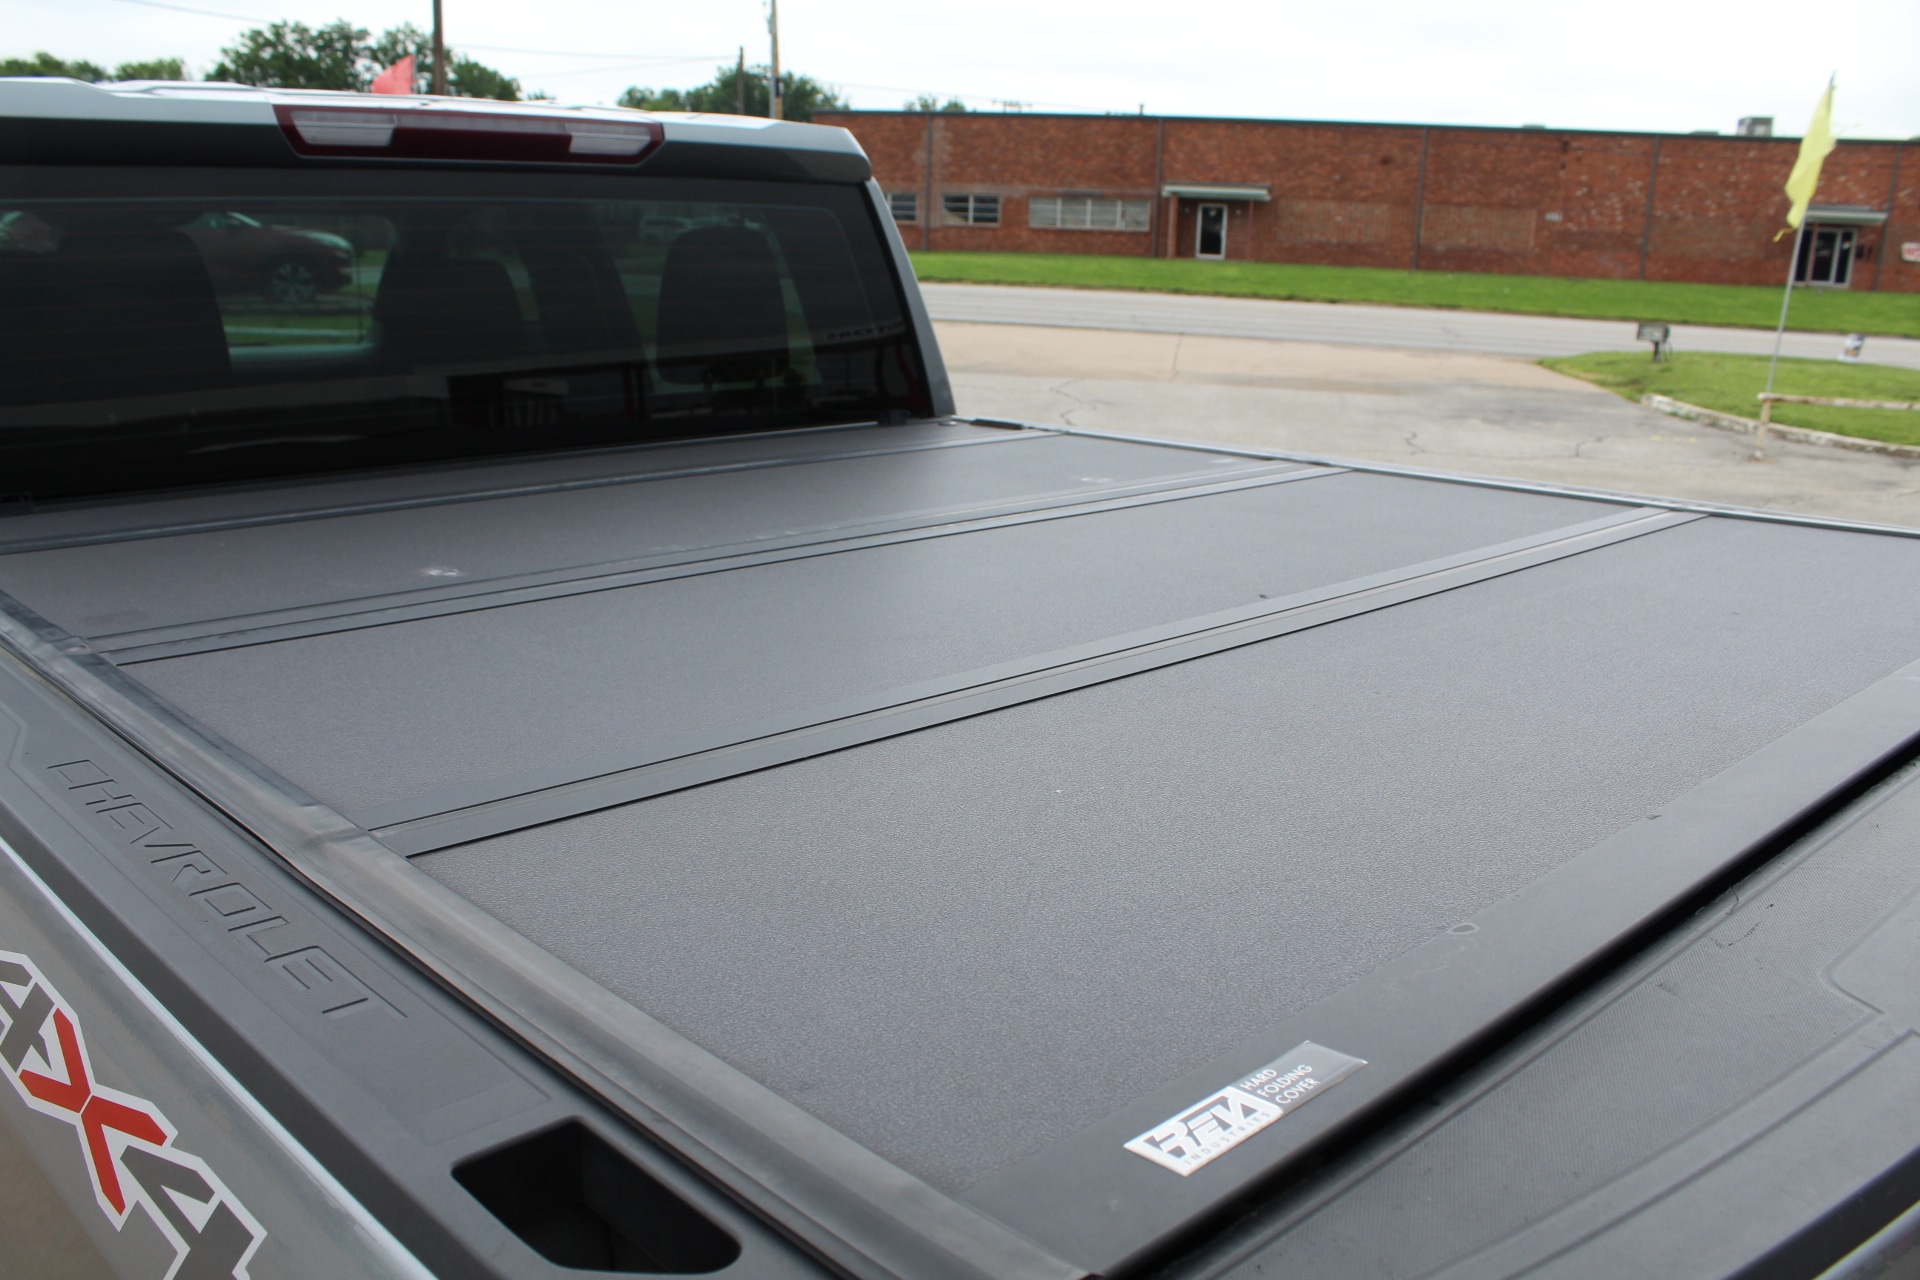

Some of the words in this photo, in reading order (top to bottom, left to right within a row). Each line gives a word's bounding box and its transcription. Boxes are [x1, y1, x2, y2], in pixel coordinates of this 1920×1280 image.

[47, 758, 408, 1018] CHEVROLET
[1240, 1068, 1277, 1091] HARD
[1256, 1064, 1313, 1098] FOLDING
[1275, 1077, 1321, 1104] COVER
[1184, 1111, 1271, 1166] INDUSTRIES
